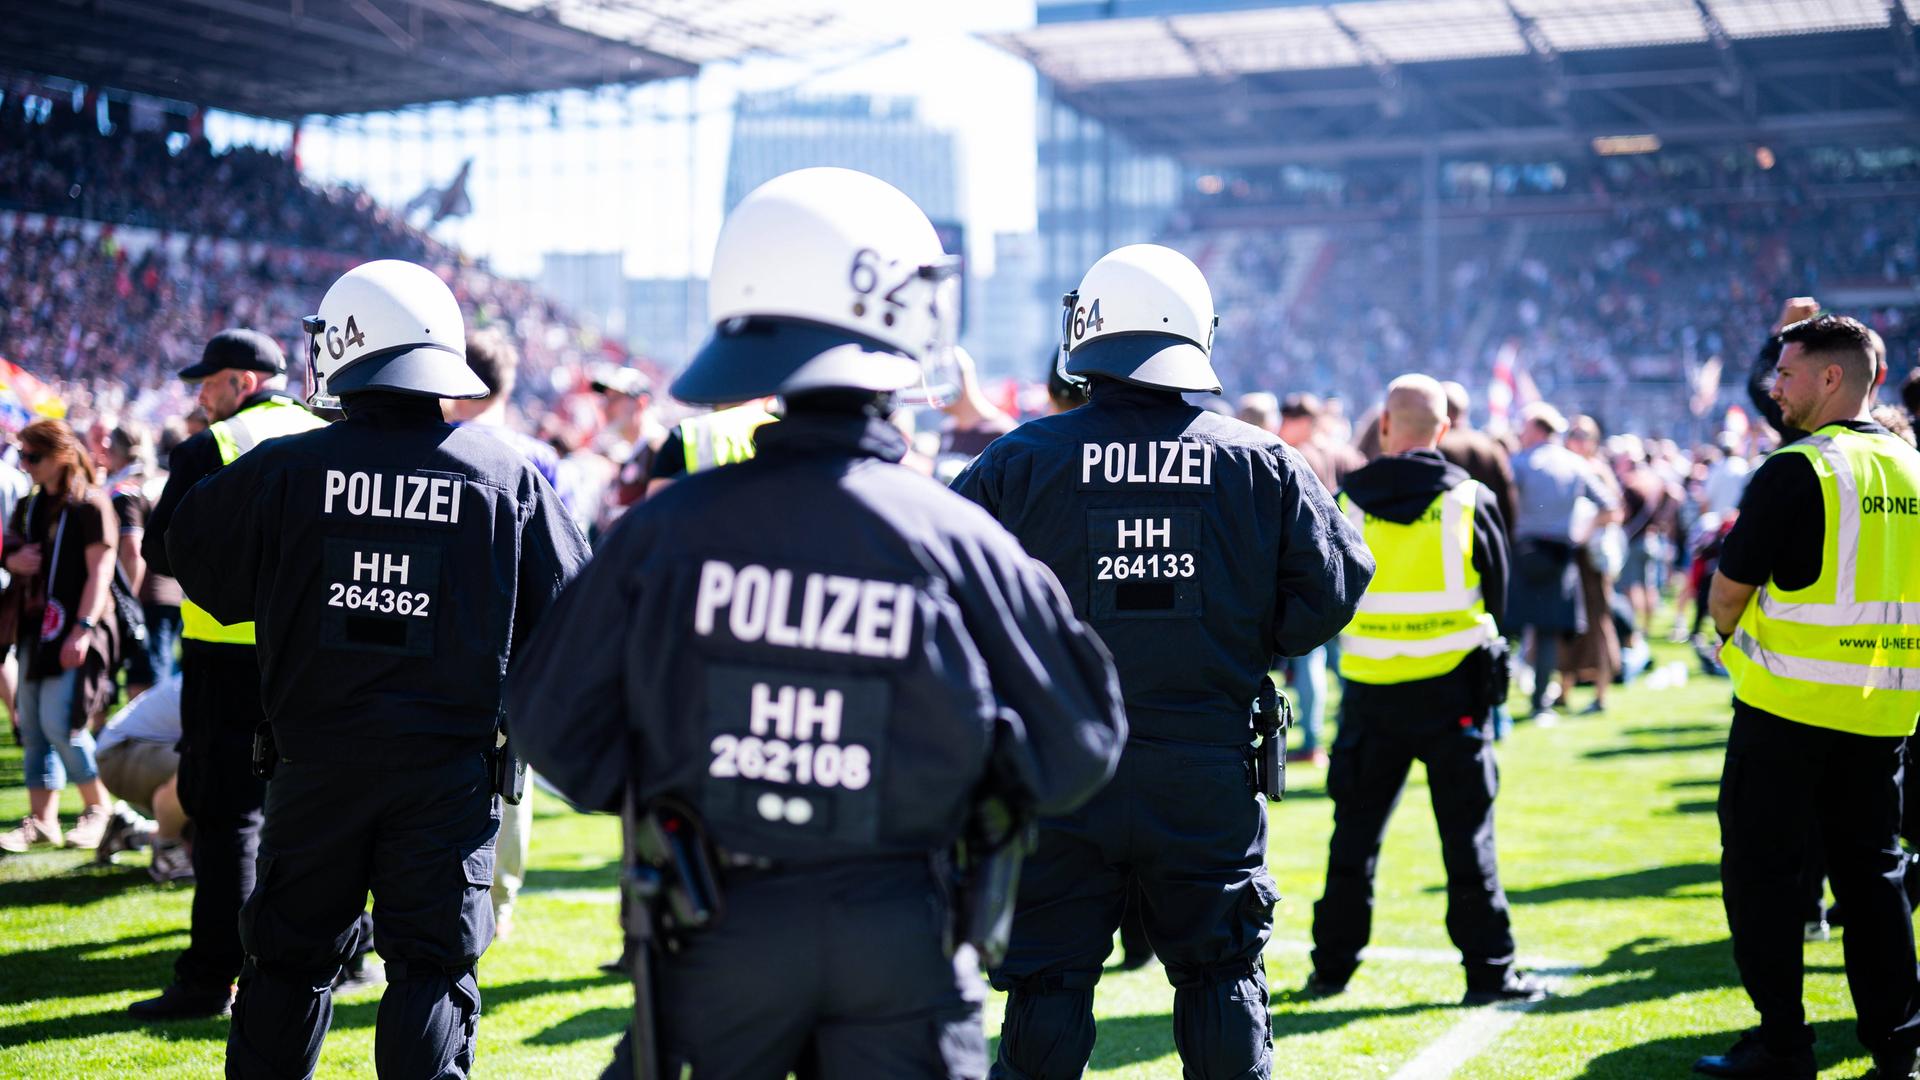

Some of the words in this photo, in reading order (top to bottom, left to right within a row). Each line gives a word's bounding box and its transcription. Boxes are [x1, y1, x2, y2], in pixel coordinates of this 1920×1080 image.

[326, 315, 365, 360] 64
[1074, 298, 1104, 340] 64
[1082, 440, 1212, 484] POLIZEI
[324, 470, 462, 523] POLIZEI
[1862, 496, 1920, 515] ORDNE
[1117, 518, 1171, 548] HH
[353, 552, 410, 585] HH
[1097, 554, 1195, 580] 264133
[328, 583, 430, 617] 264362
[694, 560, 916, 659] POLIZEI
[751, 682, 843, 742] HH
[708, 734, 871, 790] 262108
